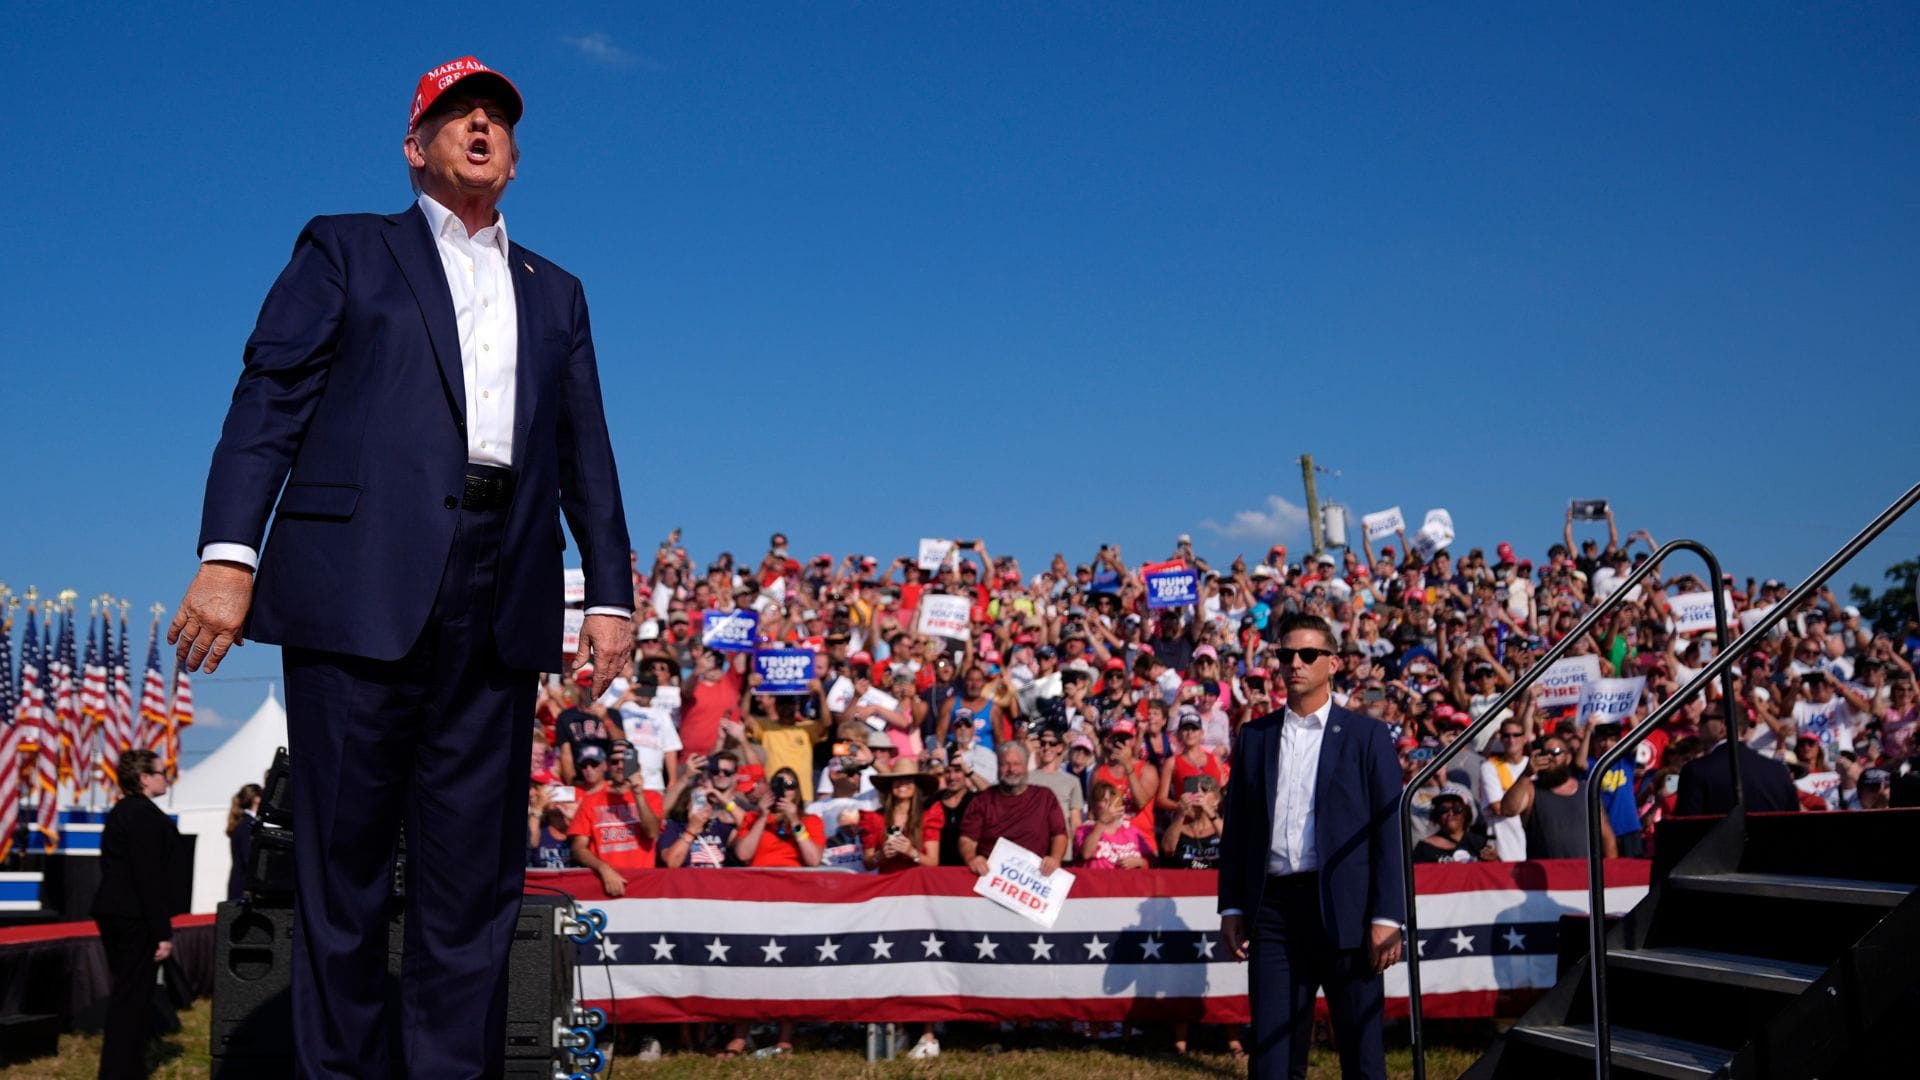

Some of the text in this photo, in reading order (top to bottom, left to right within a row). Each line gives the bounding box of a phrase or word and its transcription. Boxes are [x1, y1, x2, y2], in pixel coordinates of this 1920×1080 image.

[428, 61, 464, 81] MAKE
[438, 72, 467, 90] GRE
[1150, 575, 1194, 589] TRUMP
[1157, 584, 1189, 598] 2024
[1681, 611, 1713, 622] FIRE
[759, 656, 811, 670] TRUMP
[766, 666, 804, 680] 2024
[1544, 672, 1588, 687] YOU'RE
[1543, 686, 1578, 698] FIRE
[1588, 691, 1633, 701] YOU'RE
[1582, 700, 1634, 716] FIRED!
[1000, 863, 1052, 899] YOU'RE
[990, 876, 1049, 914] FIRED!
